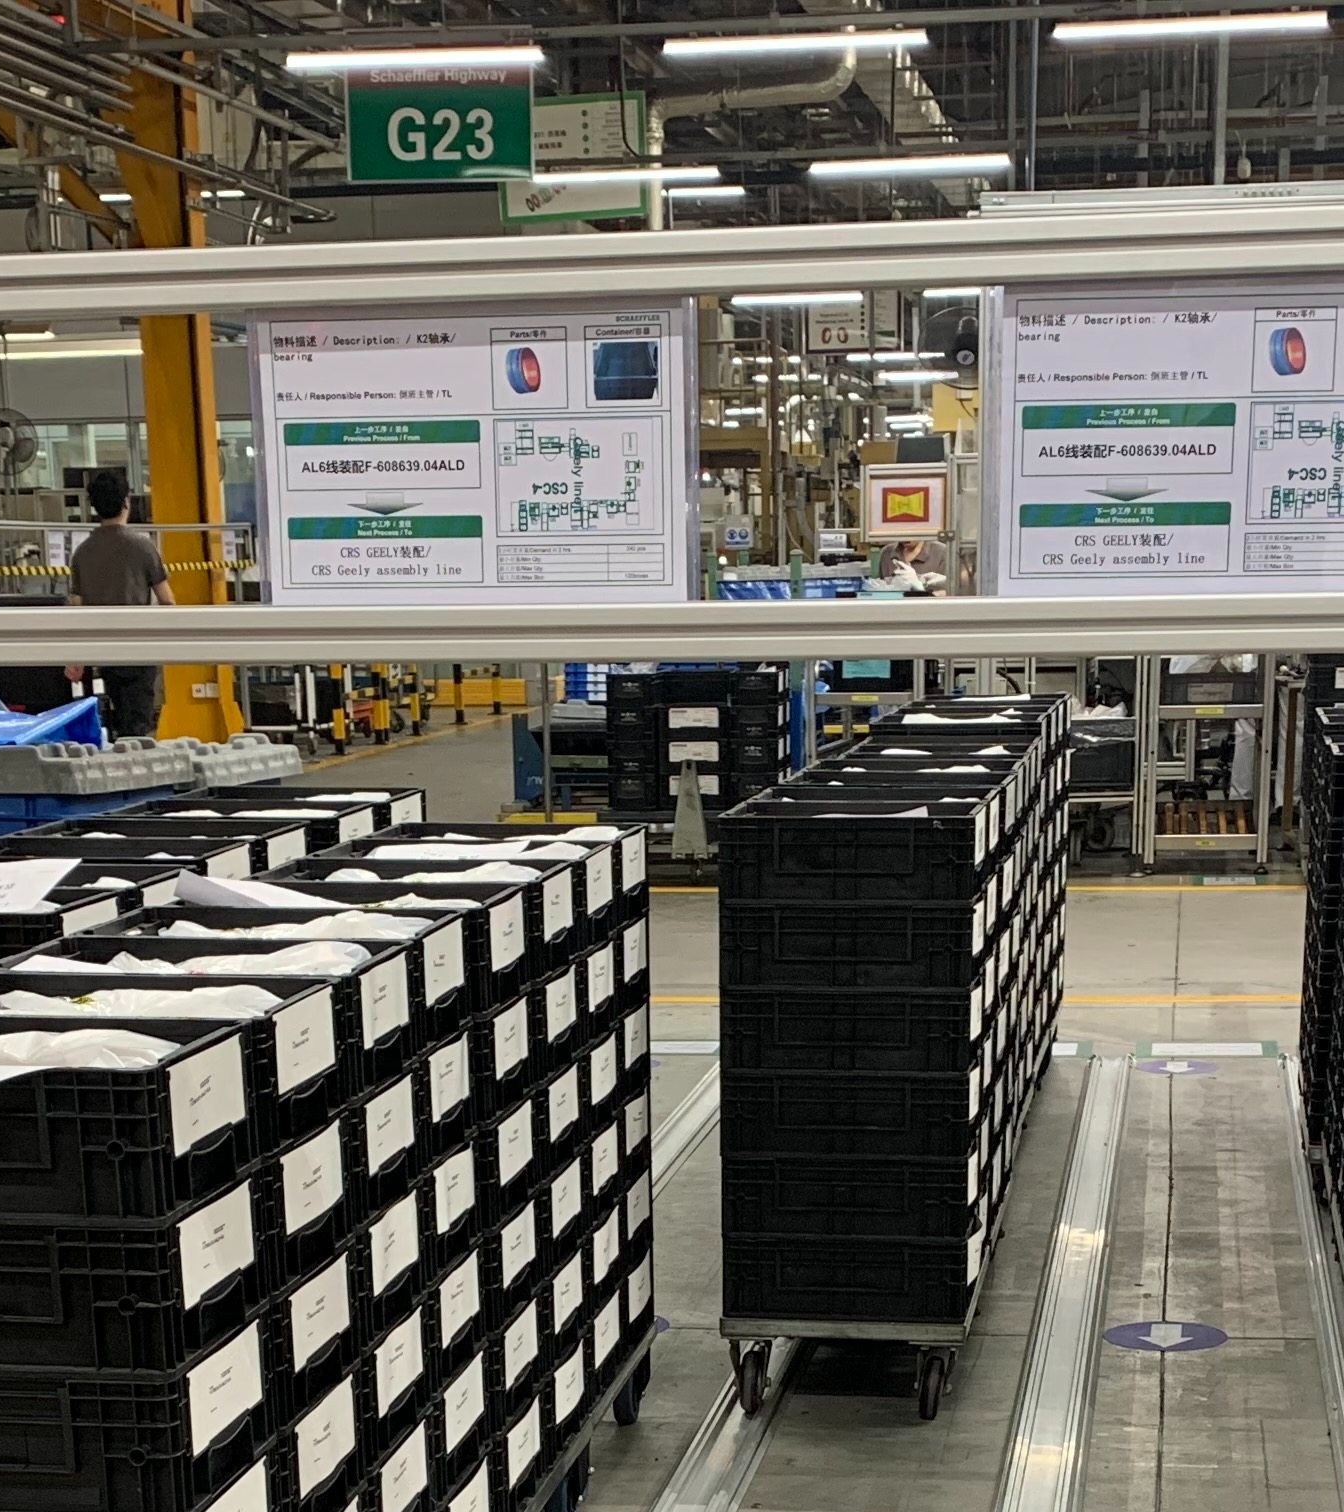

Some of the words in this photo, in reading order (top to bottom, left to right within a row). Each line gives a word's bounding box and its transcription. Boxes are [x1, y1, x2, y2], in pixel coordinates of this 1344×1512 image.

[370, 69, 441, 83] Schaeffler
[444, 68, 507, 84] Highway
[387, 107, 494, 161] G23
[1019, 314, 1066, 327] 物料描述
[1174, 312, 1217, 324] K2轴承/
[273, 336, 318, 348] 物料描述
[416, 333, 456, 344] K2轴承/
[1018, 332, 1060, 342] bearing
[273, 352, 313, 362] bearing
[1017, 373, 1045, 383] 责任人
[1053, 373, 1110, 383] Responsible
[1112, 372, 1147, 381] Person:
[1196, 371, 1208, 380] TL
[276, 392, 303, 402] 责任人
[309, 391, 362, 402] Responsible
[363, 391, 396, 400] Person:
[441, 389, 452, 398] TL
[1086, 418, 1117, 426] Previous
[1151, 417, 1170, 425] From
[1039, 443, 1216, 459] AL6线装配F-608639.04ALD
[301, 459, 465, 474] AL6线装配F-608639.04ALD
[1074, 535, 1096, 546] CRS
[1102, 533, 1174, 547] GEELY装配/
[340, 547, 360, 558] CRS
[366, 545, 432, 559] GEELY装配/
[1042, 554, 1063, 565] CRS
[1070, 553, 1105, 566] Geely
[1112, 553, 1169, 566] assembly
[1177, 552, 1205, 564] line
[311, 565, 331, 576] CRS
[337, 564, 370, 577] Geely
[376, 564, 429, 576] assembly
[436, 563, 462, 575] line
